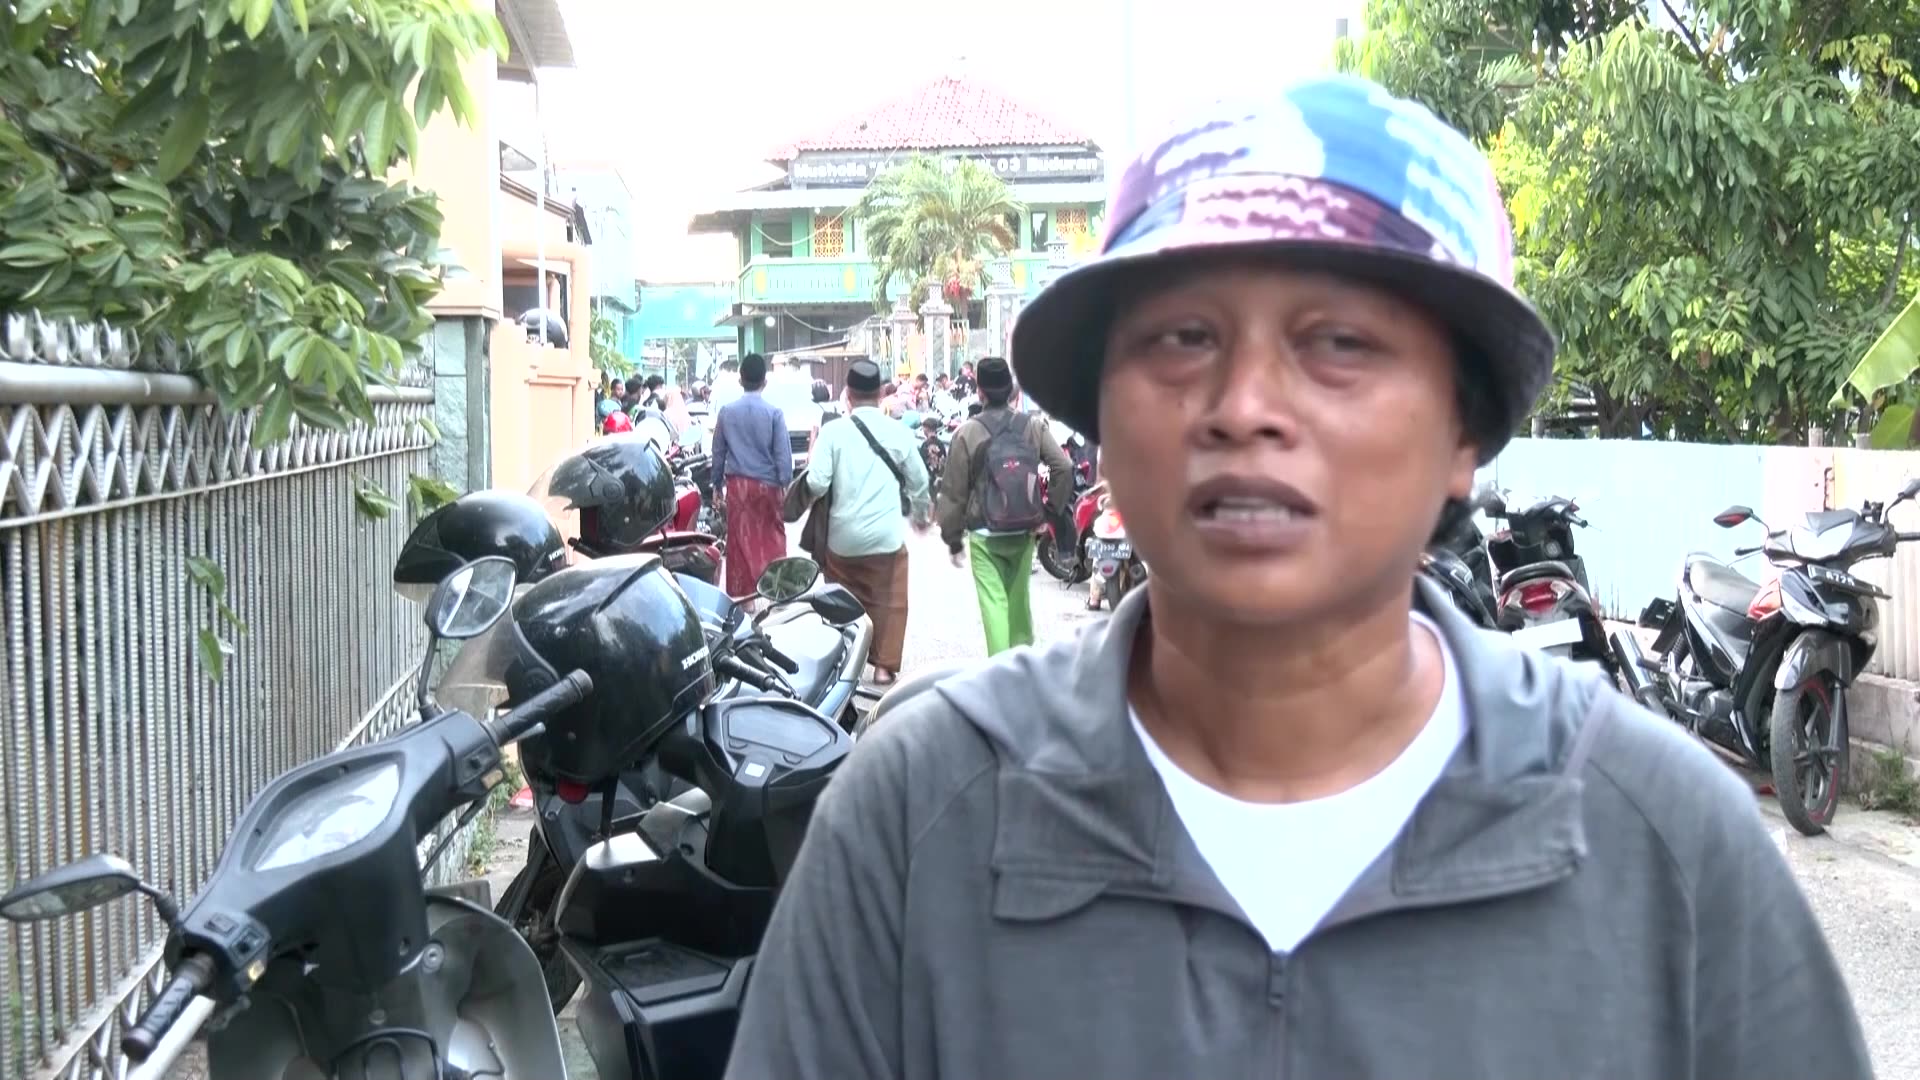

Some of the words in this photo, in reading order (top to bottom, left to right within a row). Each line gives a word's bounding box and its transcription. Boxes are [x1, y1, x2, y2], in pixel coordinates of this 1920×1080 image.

[794, 161, 867, 178] Musholla
[997, 156, 1021, 172] 03
[1026, 156, 1098, 172] Buduran
